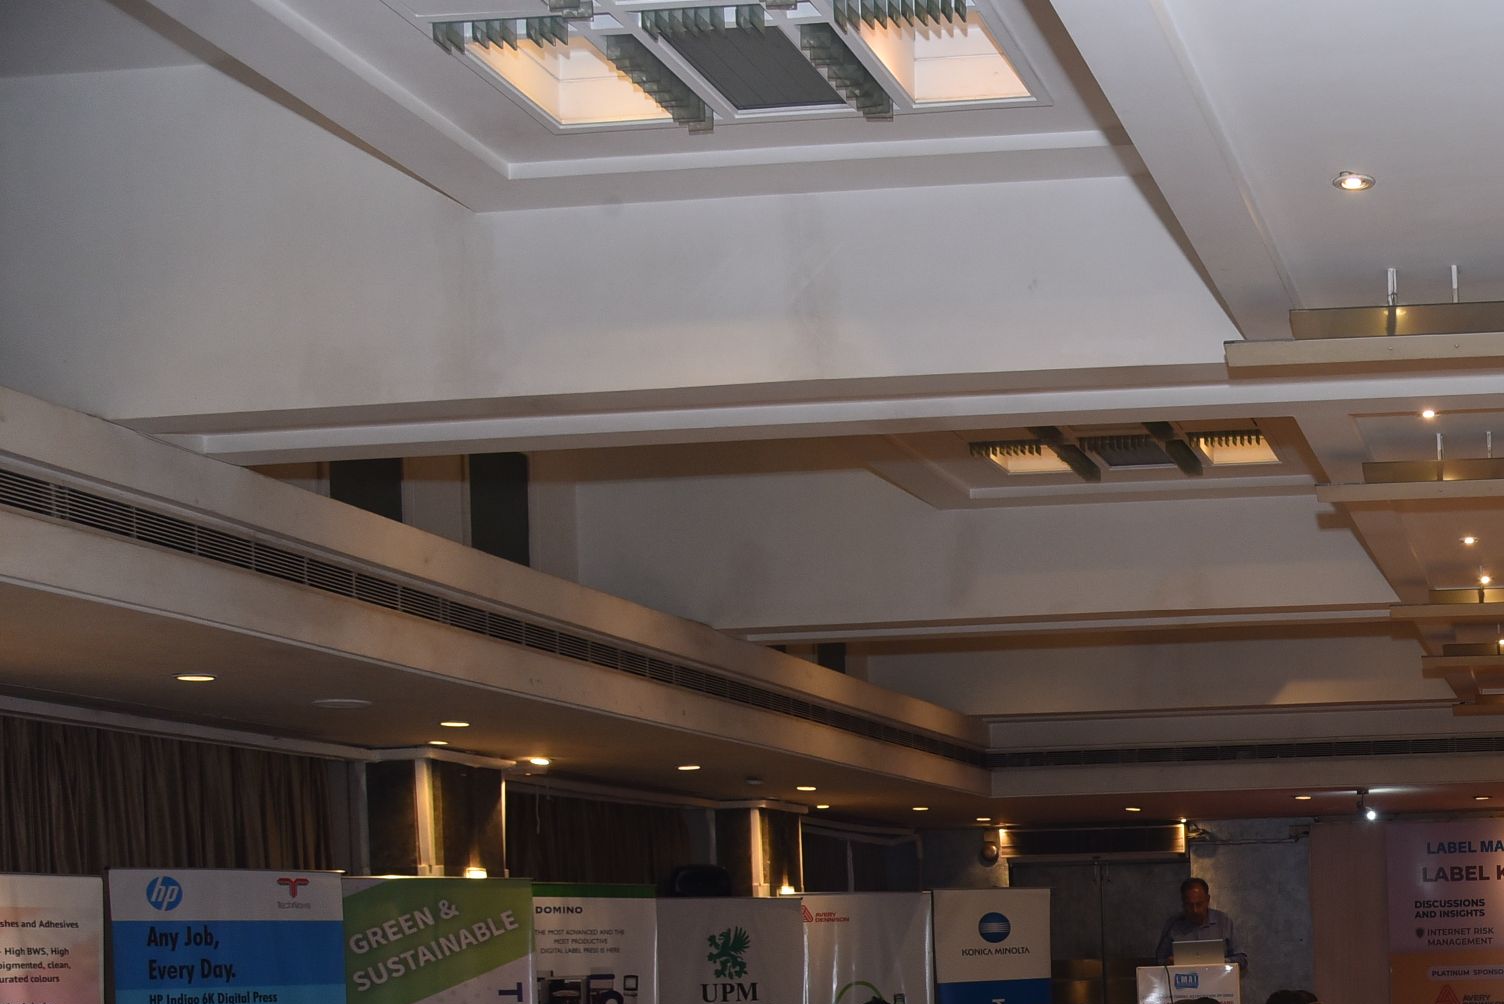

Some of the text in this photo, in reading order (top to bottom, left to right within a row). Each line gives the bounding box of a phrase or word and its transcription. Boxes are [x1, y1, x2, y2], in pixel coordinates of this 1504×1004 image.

[1426, 840, 1477, 854] LABEL
[1422, 864, 1490, 882] LABEL
[1414, 898, 1486, 908] DISCUSSIONS
[535, 906, 583, 914] DOMINO
[1414, 909, 1486, 919] AND INSIGHTS
[21, 920, 37, 928] and
[39, 920, 79, 928] Adhesives
[348, 898, 460, 956] GREEN &
[1427, 927, 1494, 936] INTERNET RISK
[146, 924, 220, 951] Any Job,
[1428, 937, 1494, 946] MANAGEMENT
[4, 947, 70, 957] High BWS, High
[351, 909, 520, 992] SUSTAINABLE
[961, 946, 1030, 956] KONICA MINOLTA
[47, 961, 72, 970] clean,
[148, 958, 236, 984] Every Day.
[30, 975, 60, 983] colours
[699, 982, 759, 1002] UPM
[201, 993, 215, 1004] 6K
[252, 991, 278, 1003] Press
